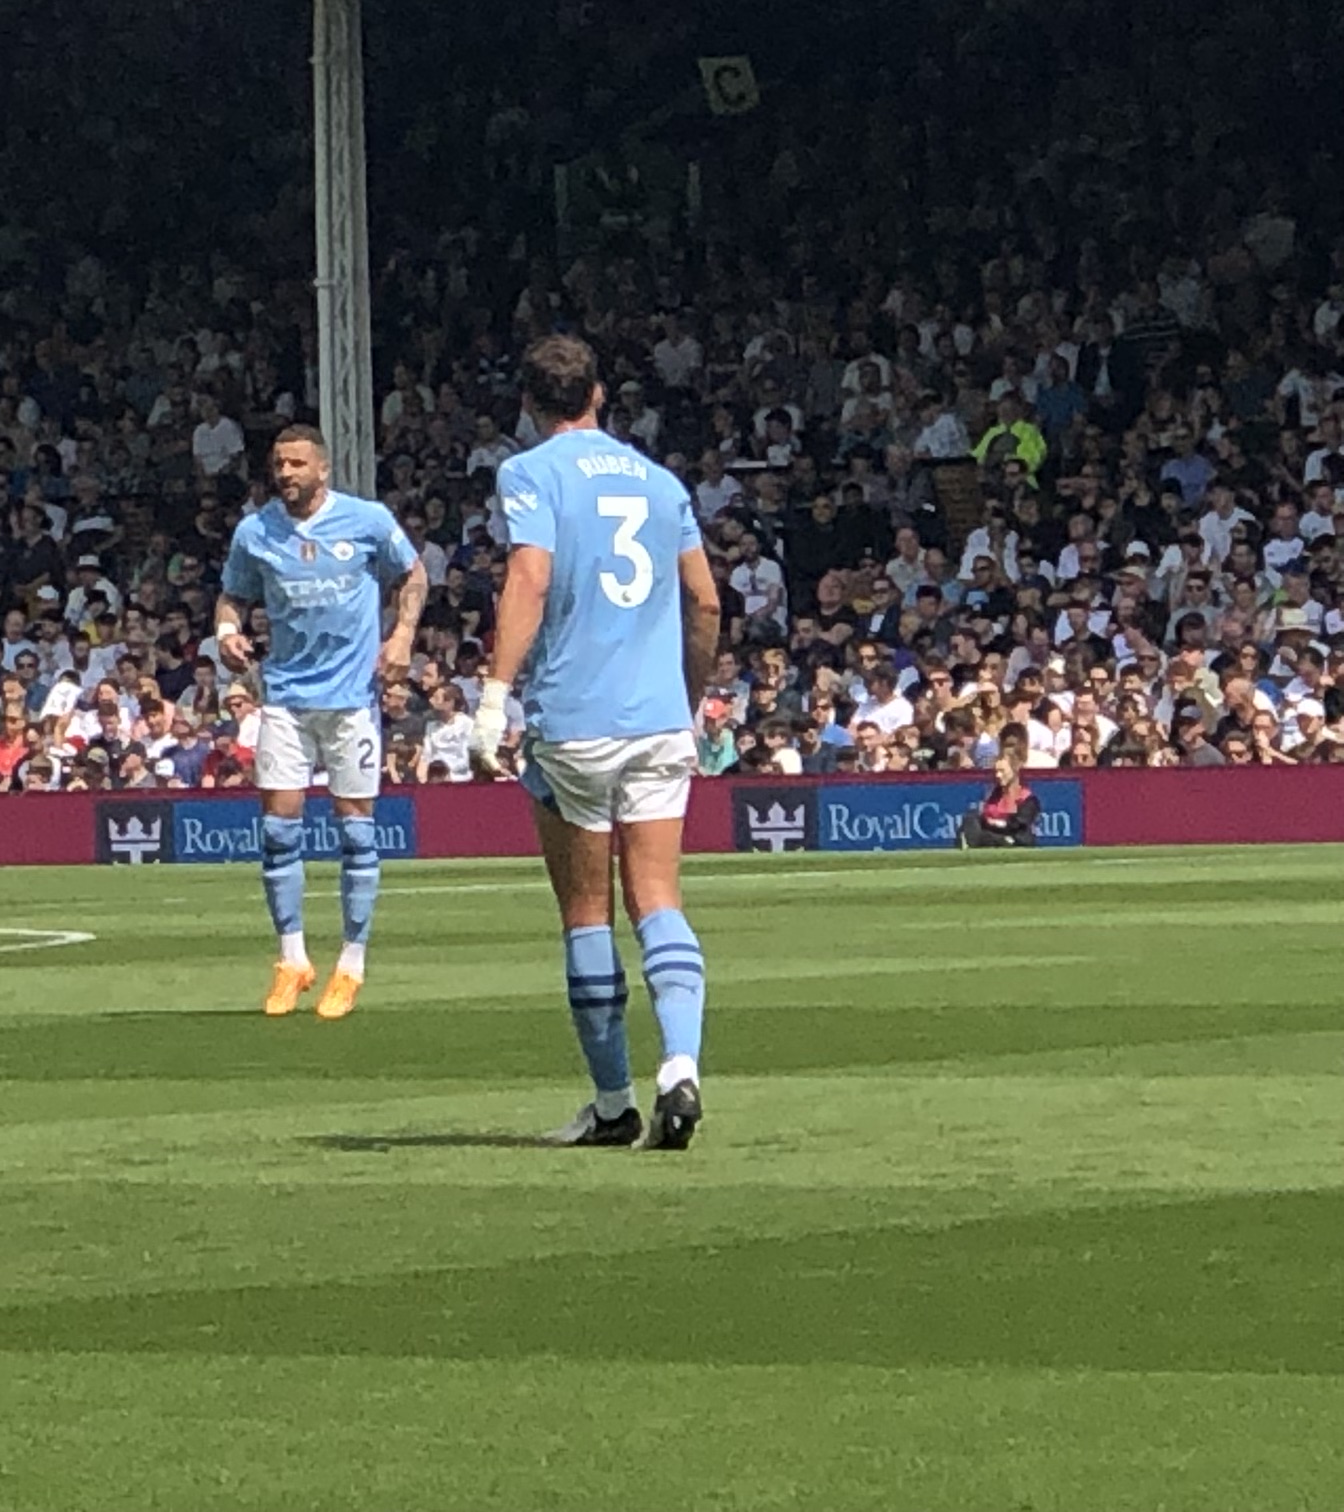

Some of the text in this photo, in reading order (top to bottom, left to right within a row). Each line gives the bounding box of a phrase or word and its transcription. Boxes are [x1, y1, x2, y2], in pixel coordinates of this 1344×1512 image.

[576, 454, 648, 481] RUBEN
[597, 495, 654, 609] 3
[357, 738, 375, 769] 2
